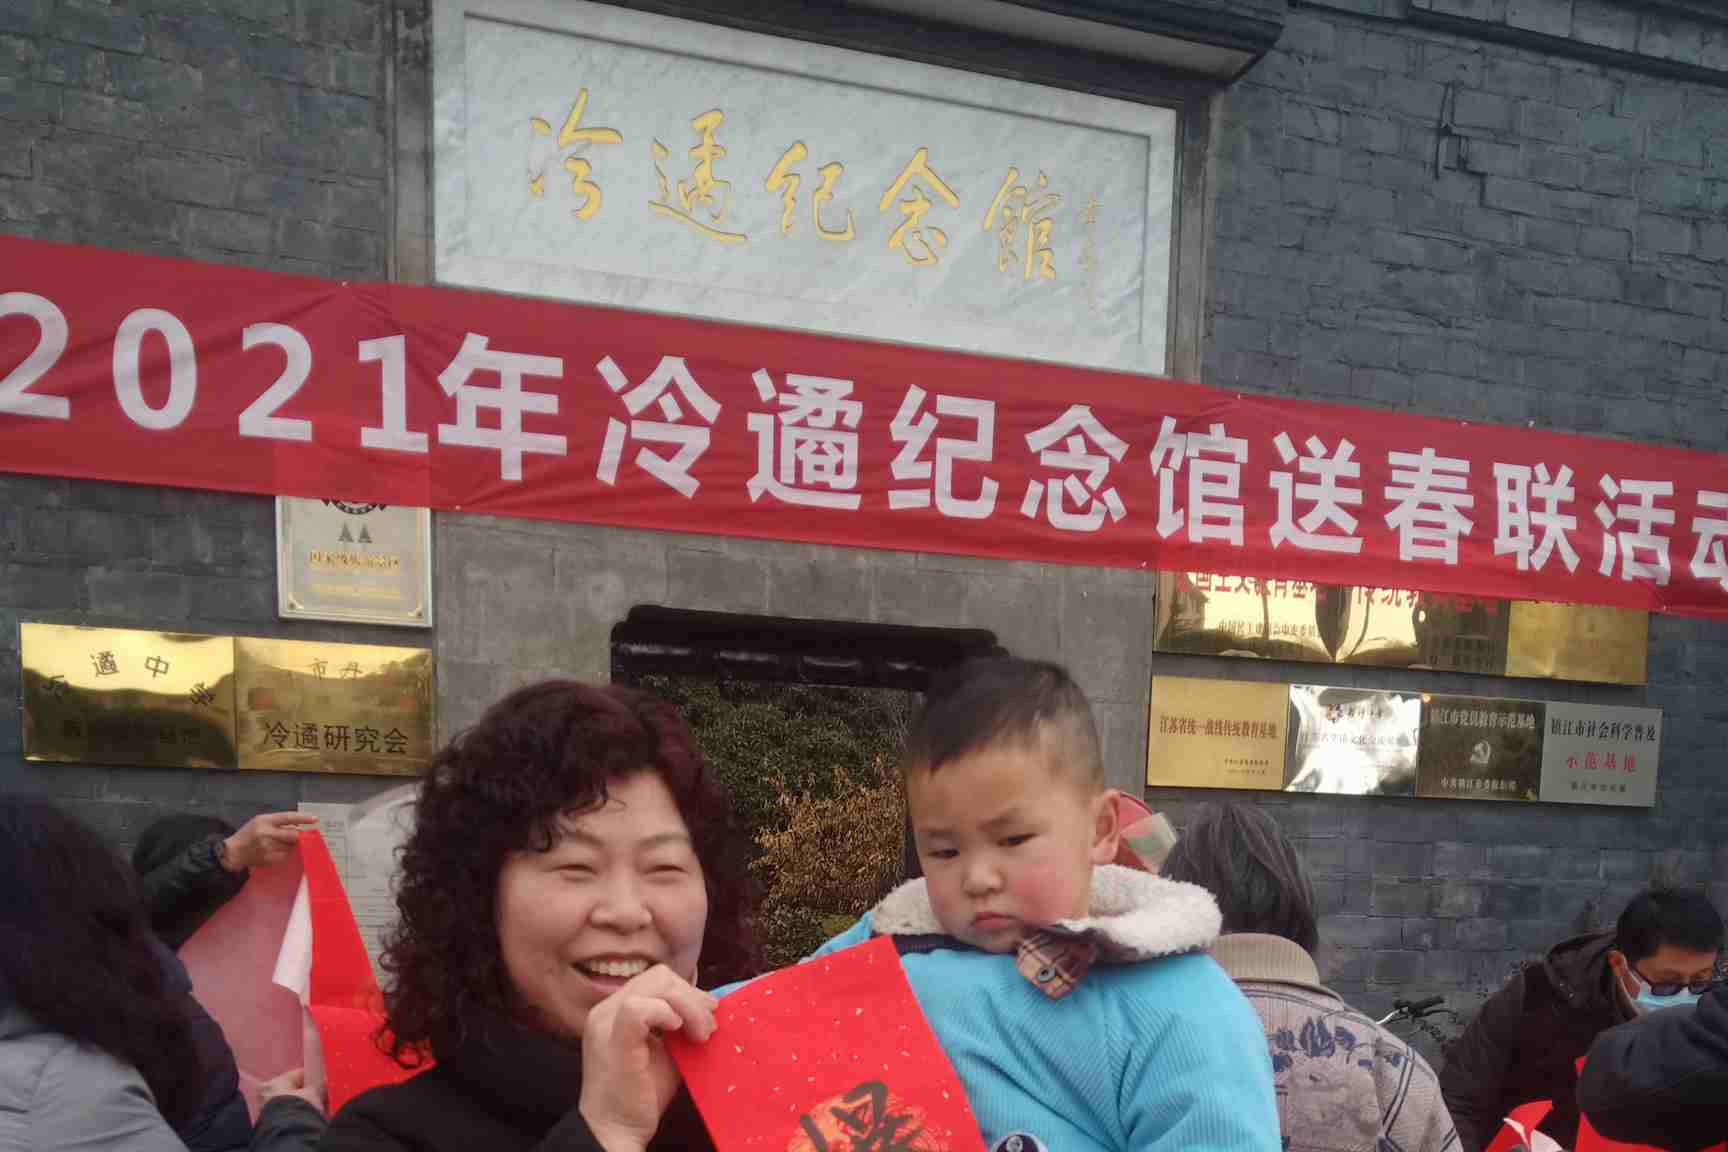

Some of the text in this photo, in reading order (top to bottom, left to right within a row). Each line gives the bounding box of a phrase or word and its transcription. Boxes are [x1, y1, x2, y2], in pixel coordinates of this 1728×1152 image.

[263, 719, 410, 755] 冷遹研究会
